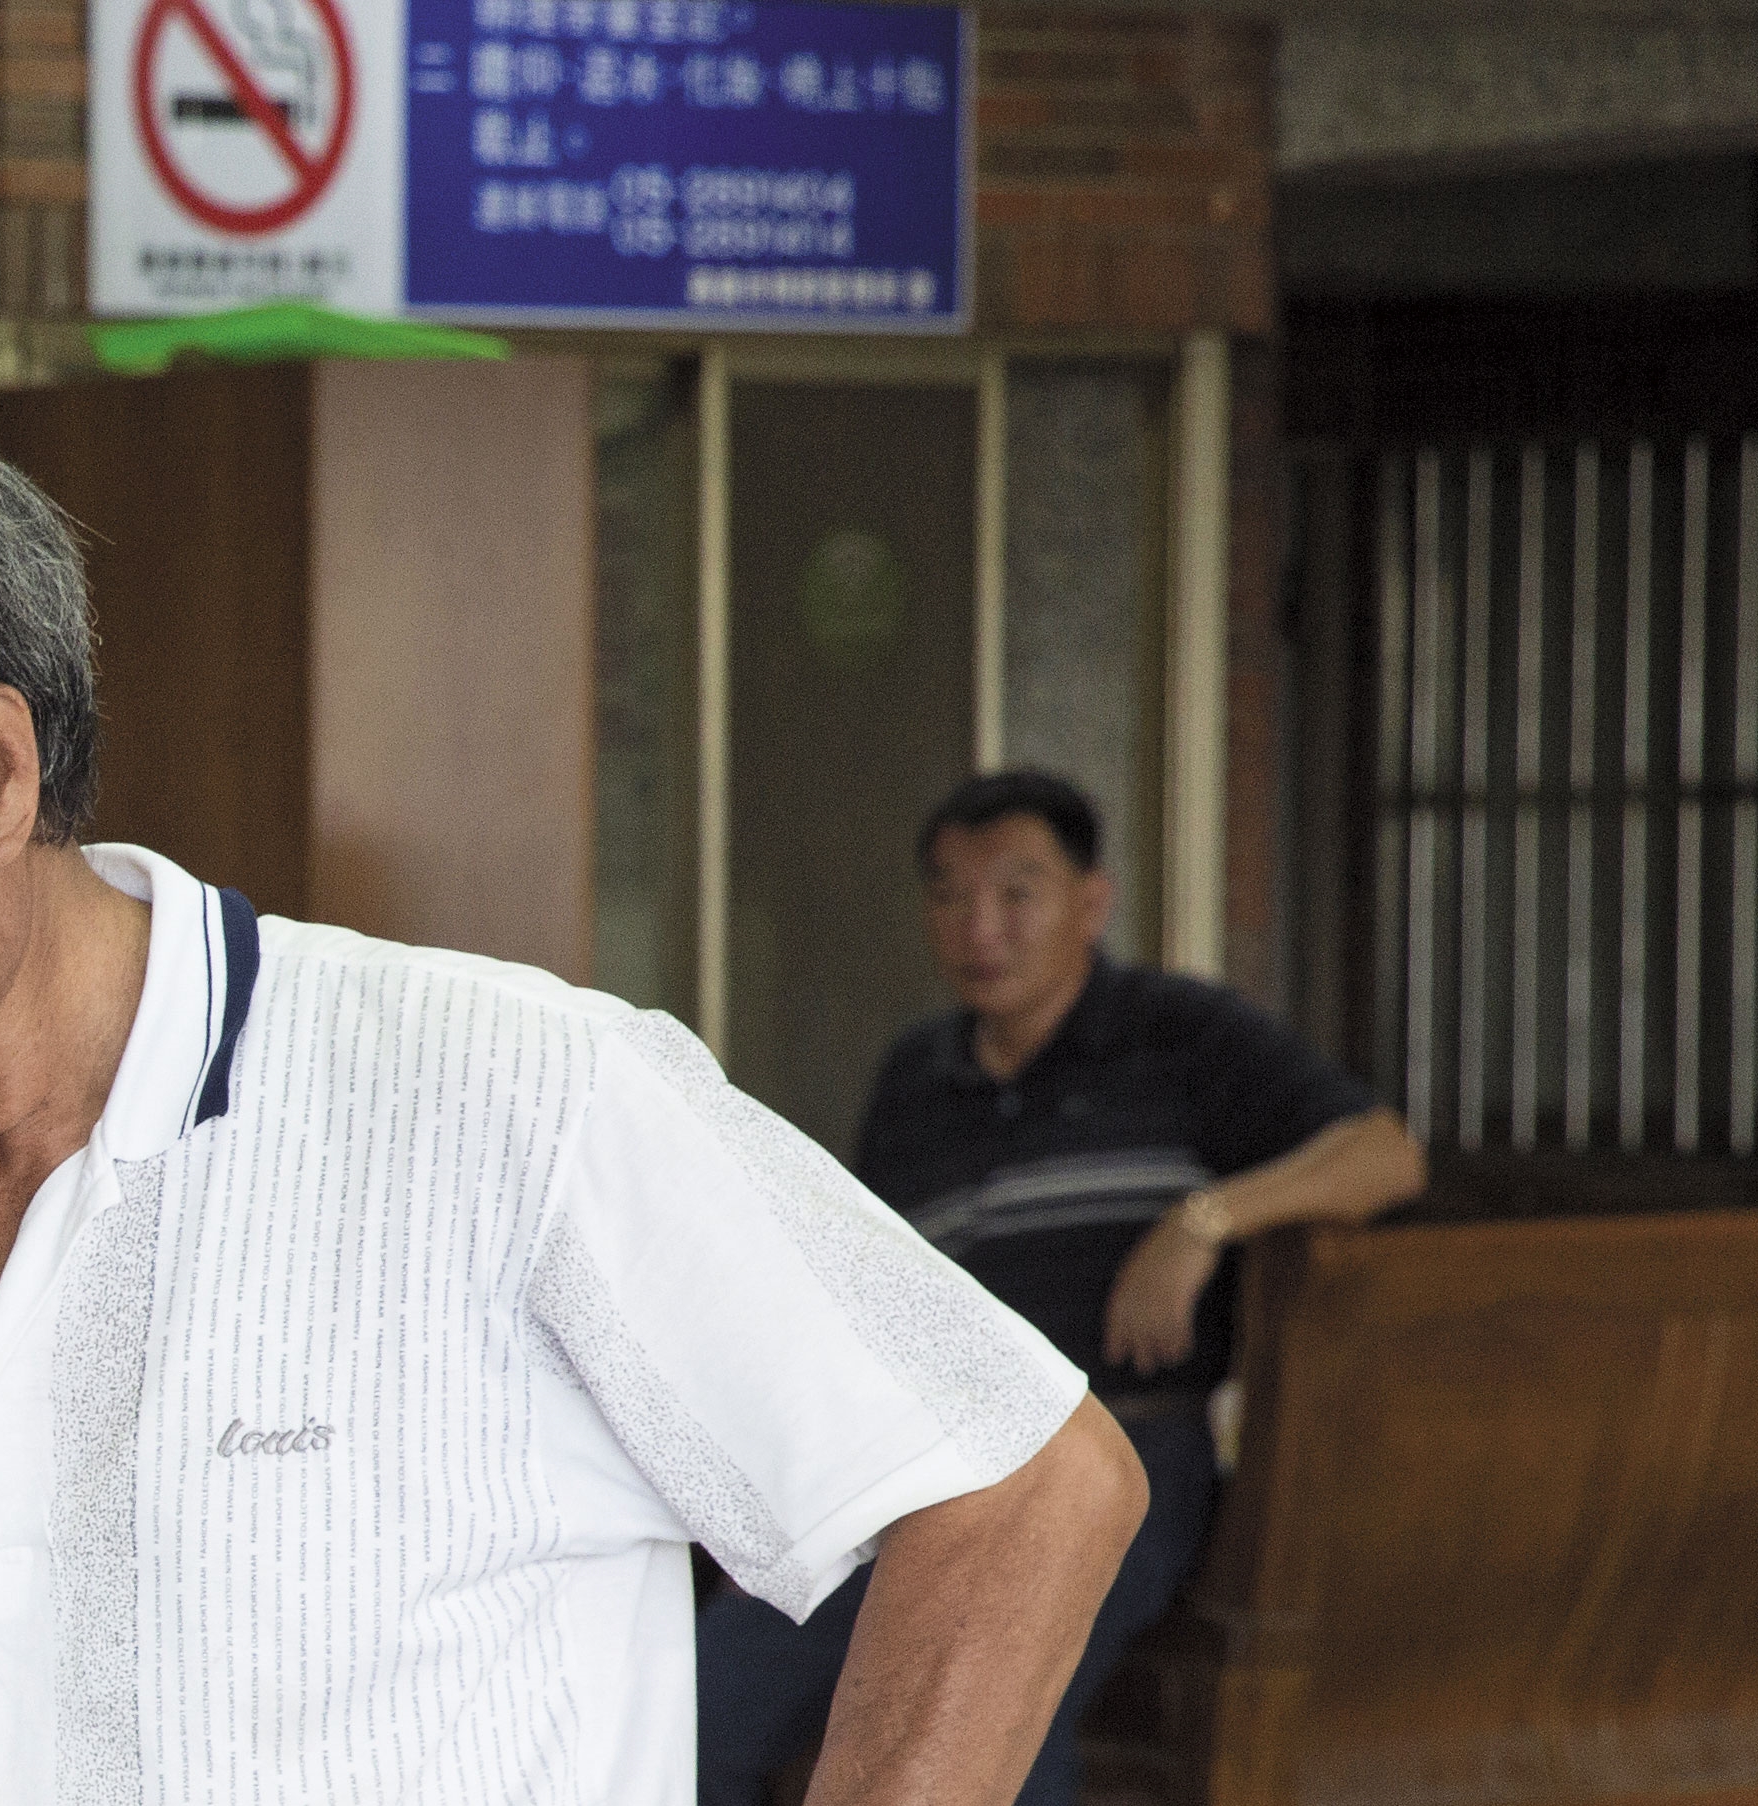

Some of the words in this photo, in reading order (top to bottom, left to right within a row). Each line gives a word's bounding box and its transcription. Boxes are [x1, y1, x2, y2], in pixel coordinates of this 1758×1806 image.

[281, 1071, 291, 1108] FASHION
[369, 1079, 378, 1118] FASHION
[323, 1108, 333, 1146] FASHION
[345, 1103, 353, 1142] FASHION
[389, 1104, 398, 1144] FASHION
[250, 1137, 261, 1191] COLLECTION
[296, 1134, 307, 1172] FASHION
[432, 1125, 441, 1167] FASHION
[341, 1145, 352, 1200] COLLECTION
[384, 1147, 396, 1204] COLLECTION
[427, 1170, 437, 1228] COLLECTION
[194, 1194, 209, 1250] COLLECTION
[402, 1202, 411, 1260] COLLECTION
[355, 1239, 365, 1296] COLLECTION
[399, 1263, 408, 1304] FASHION
[209, 1298, 218, 1339] FASHION
[258, 1284, 267, 1325] FASHION
[353, 1299, 361, 1340] FASHION
[233, 1313, 241, 1354] FASHION
[303, 1325, 313, 1365] FASHION
[328, 1323, 336, 1363] FASHION
[375, 1328, 383, 1369] FASHION
[373, 1372, 382, 1427] COLLECTION
[153, 1504, 161, 1544] FASHION
[200, 1519, 208, 1559] FASHION
[175, 1594, 183, 1634] FASHION
[177, 1637, 186, 1692] COLLECTION
[204, 1739, 213, 1778] FASHION
